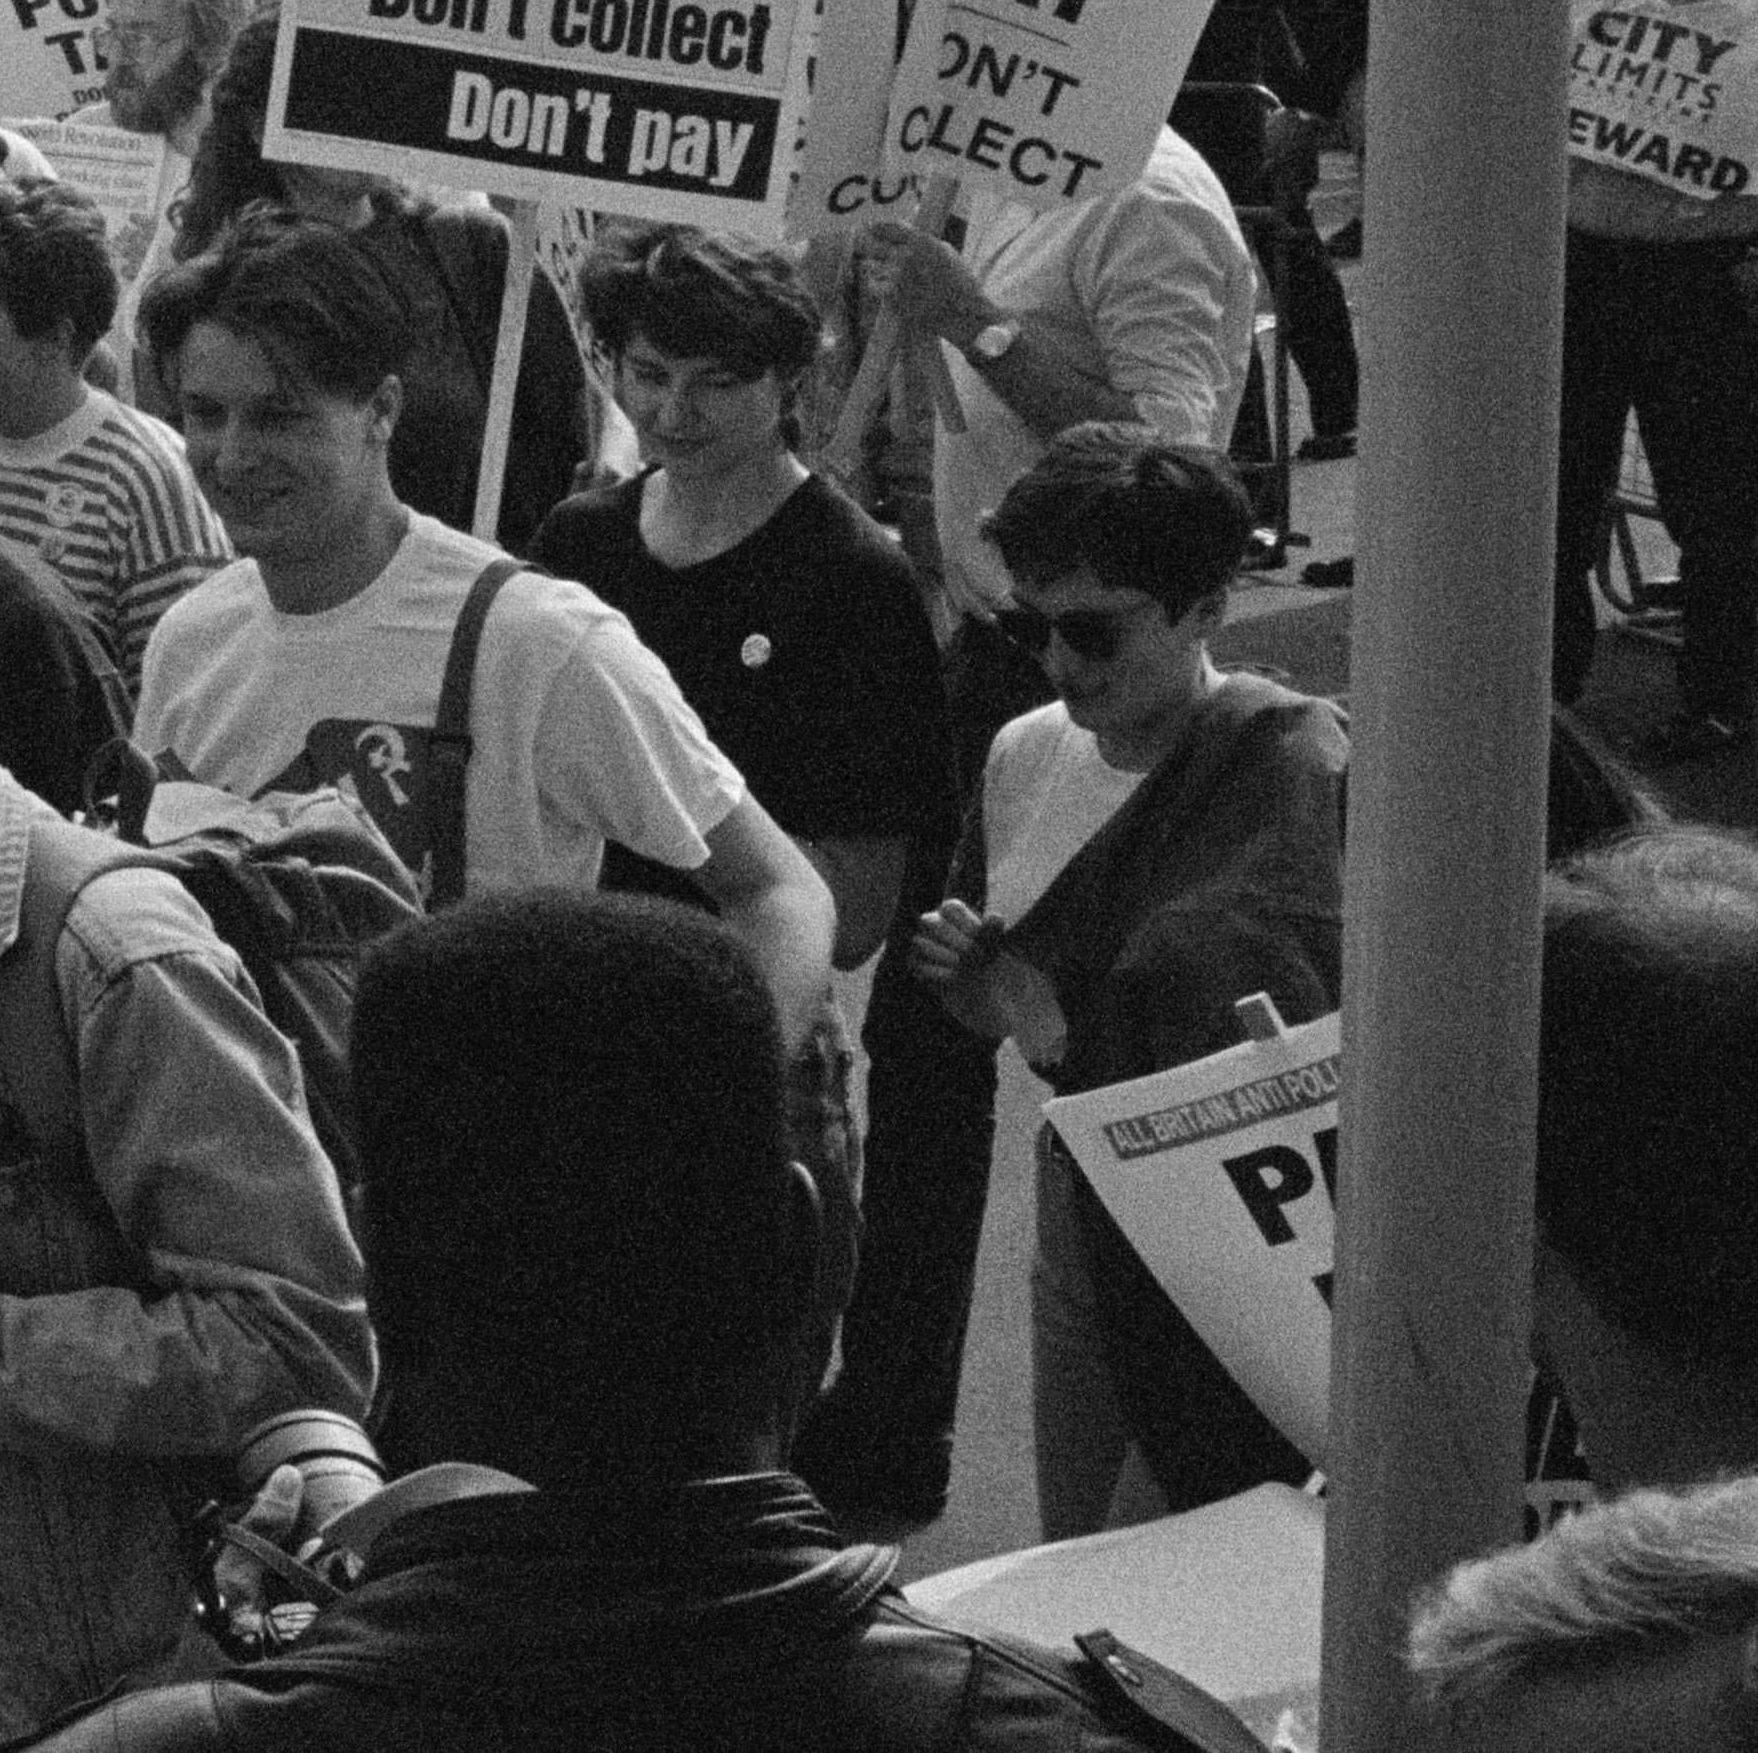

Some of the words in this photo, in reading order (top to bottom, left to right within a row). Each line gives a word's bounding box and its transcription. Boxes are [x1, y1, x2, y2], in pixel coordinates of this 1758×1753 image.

[1571, 43, 1722, 111] LIMITS
[1587, 10, 1738, 76] CITY
[445, 68, 615, 165] Don't
[627, 94, 755, 188] pay
[1110, 1120, 1151, 1152] ALL
[1147, 1092, 1239, 1145] BRITAIN
[1235, 1078, 1284, 1120] ANTI
